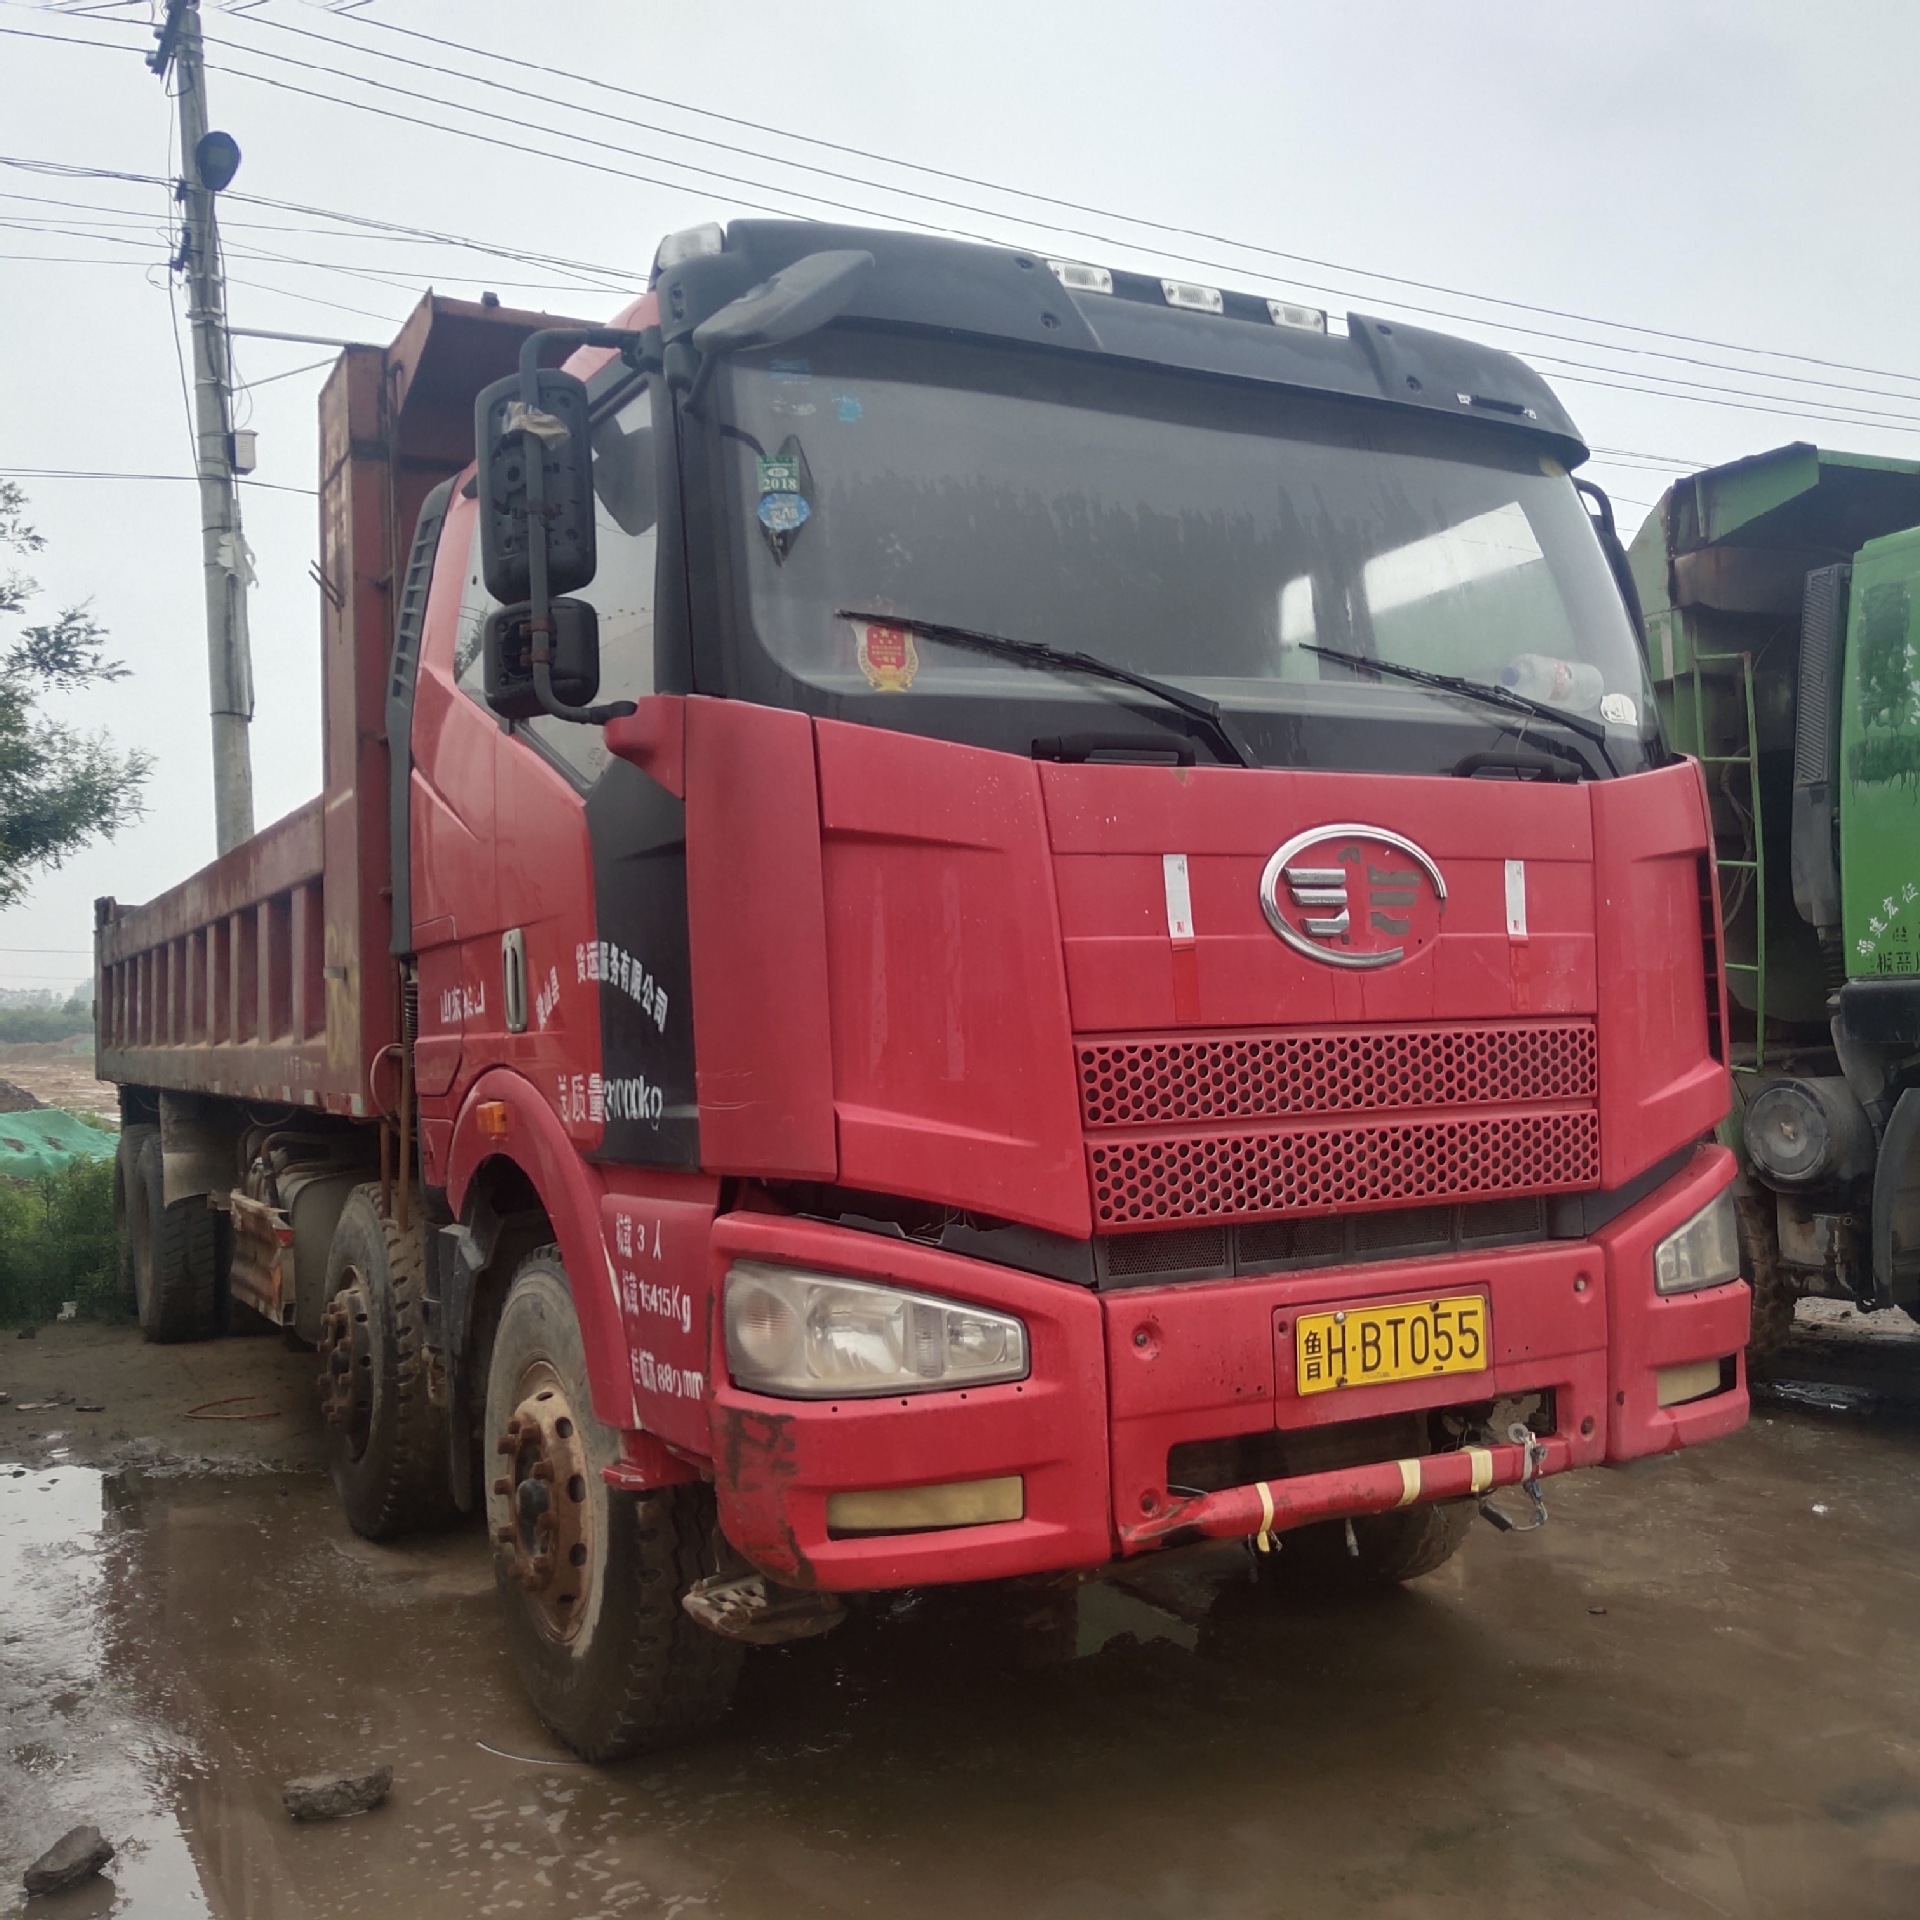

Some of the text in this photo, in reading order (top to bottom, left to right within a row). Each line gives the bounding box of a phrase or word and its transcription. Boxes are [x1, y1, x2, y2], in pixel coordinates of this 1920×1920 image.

[763, 478, 797, 491] 2018
[576, 941, 668, 1033] 货运服务有限公司
